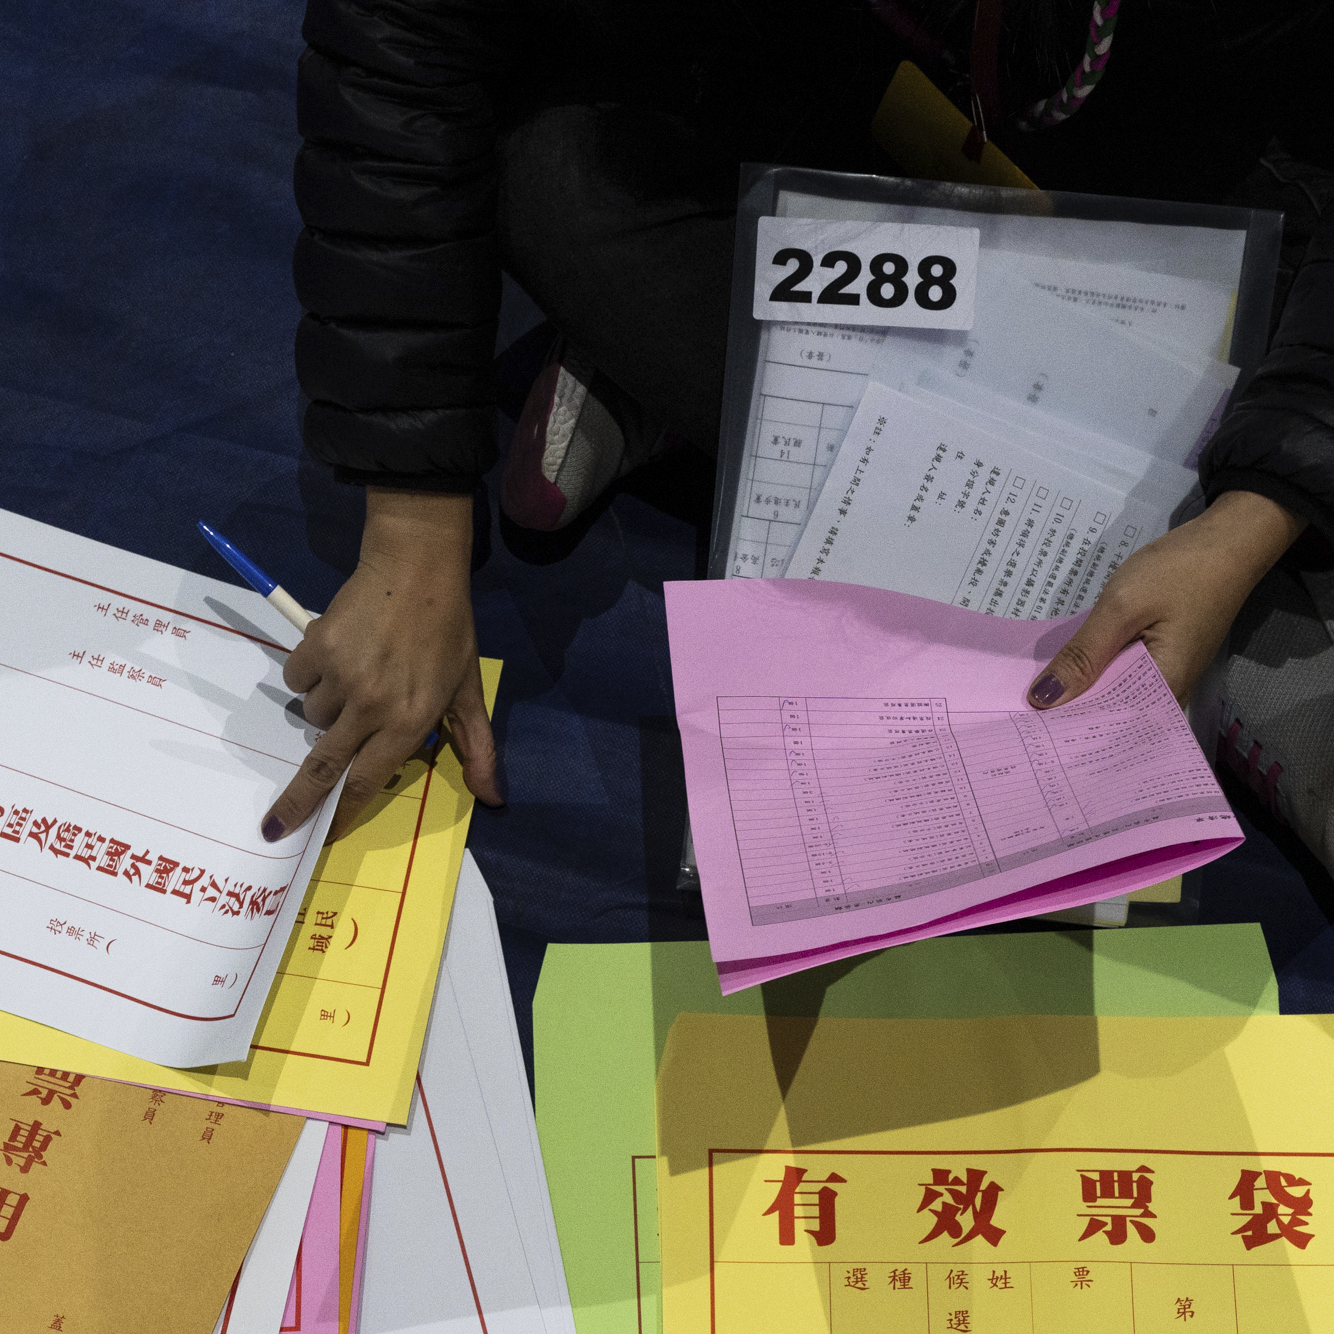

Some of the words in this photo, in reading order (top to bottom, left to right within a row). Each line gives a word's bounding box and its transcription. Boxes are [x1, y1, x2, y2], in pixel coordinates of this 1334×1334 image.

[767, 248, 958, 311] 2288
[771, 435, 802, 448] 親民黨
[779, 449, 791, 461] 14
[772, 511, 779, 520] 6
[1011, 514, 1065, 619] 10.於投票所以攝影器材
[1050, 526, 1097, 619] 9.在投開票所有其他
[94, 602, 191, 640] 主任管理員
[68, 649, 167, 688] 主任監察員
[761, 1164, 1316, 1251] 有效票袋
[1174, 1296, 1196, 1323] 第
